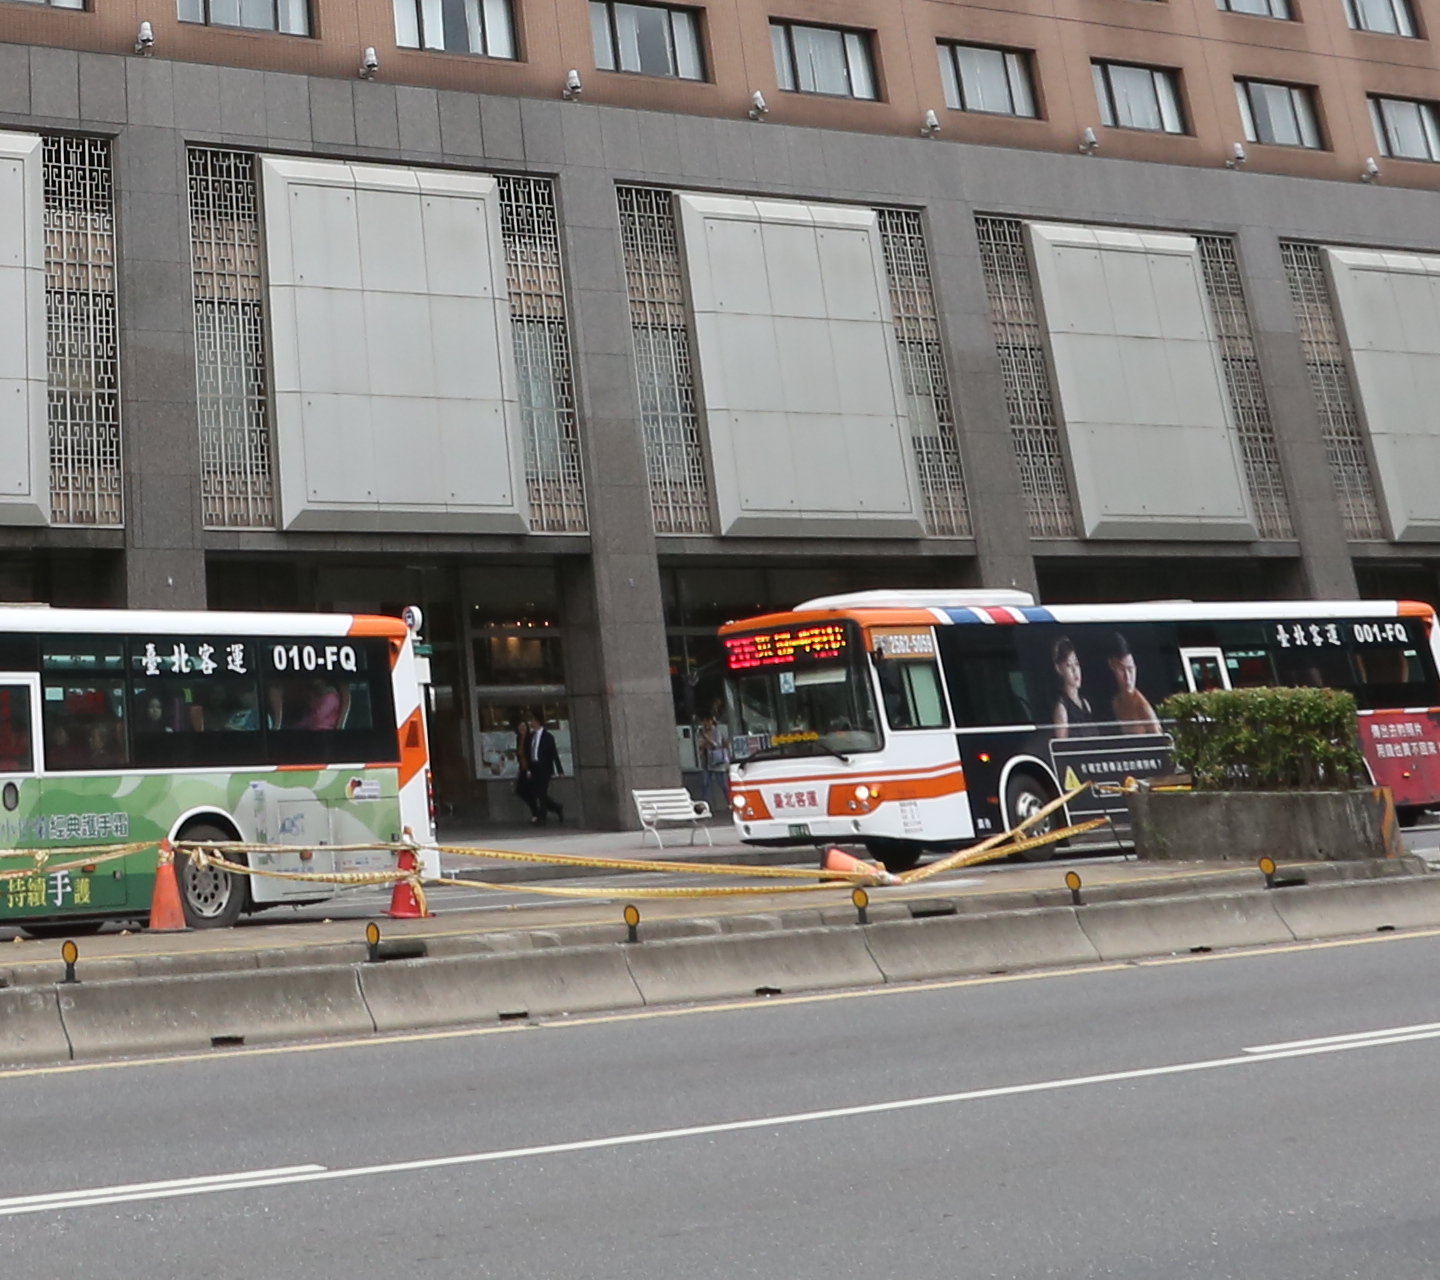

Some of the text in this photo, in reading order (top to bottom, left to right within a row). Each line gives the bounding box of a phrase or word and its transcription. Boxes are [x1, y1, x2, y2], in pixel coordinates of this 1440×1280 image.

[1275, 623, 1342, 648] 臺北客運
[1352, 622, 1409, 644] 001-FQ
[141, 642, 248, 676] 臺北客運
[272, 644, 358, 674] 010-FQ
[772, 790, 820, 810] 臺北客運
